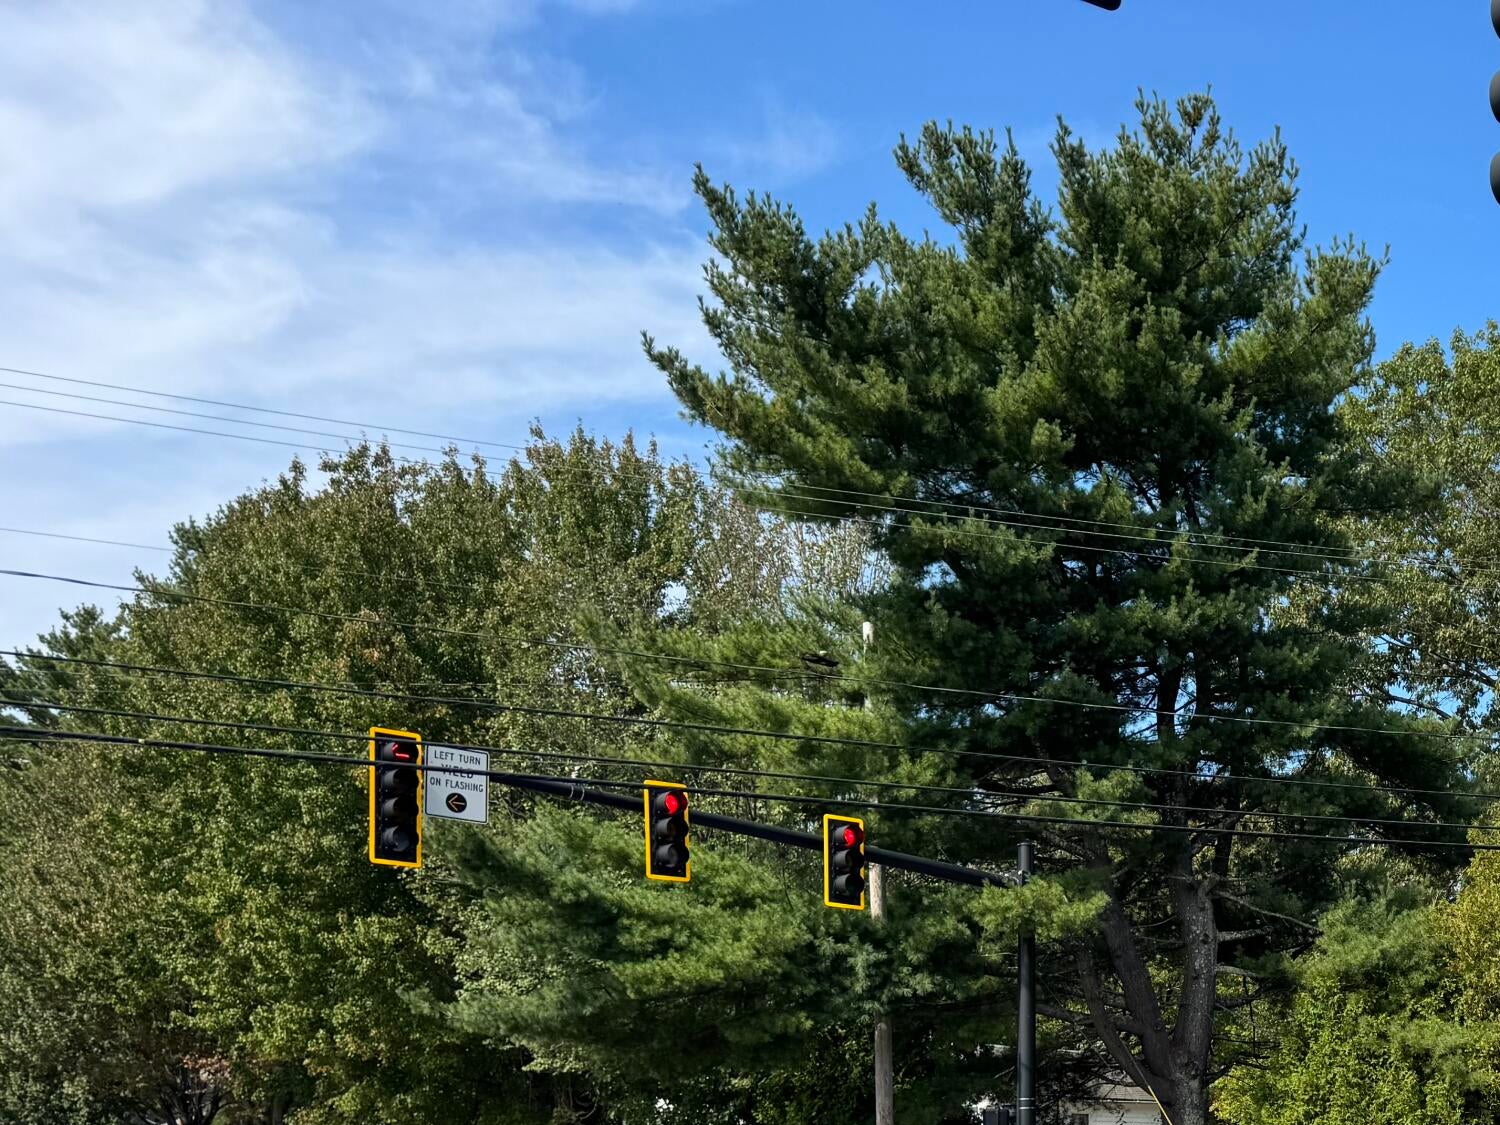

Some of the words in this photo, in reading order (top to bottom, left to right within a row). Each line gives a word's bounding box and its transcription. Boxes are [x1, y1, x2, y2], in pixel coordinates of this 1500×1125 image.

[434, 750, 454, 762] LEFT
[459, 754, 481, 766] TURN
[429, 777, 441, 787] ON
[445, 779, 484, 793] FLASHING
